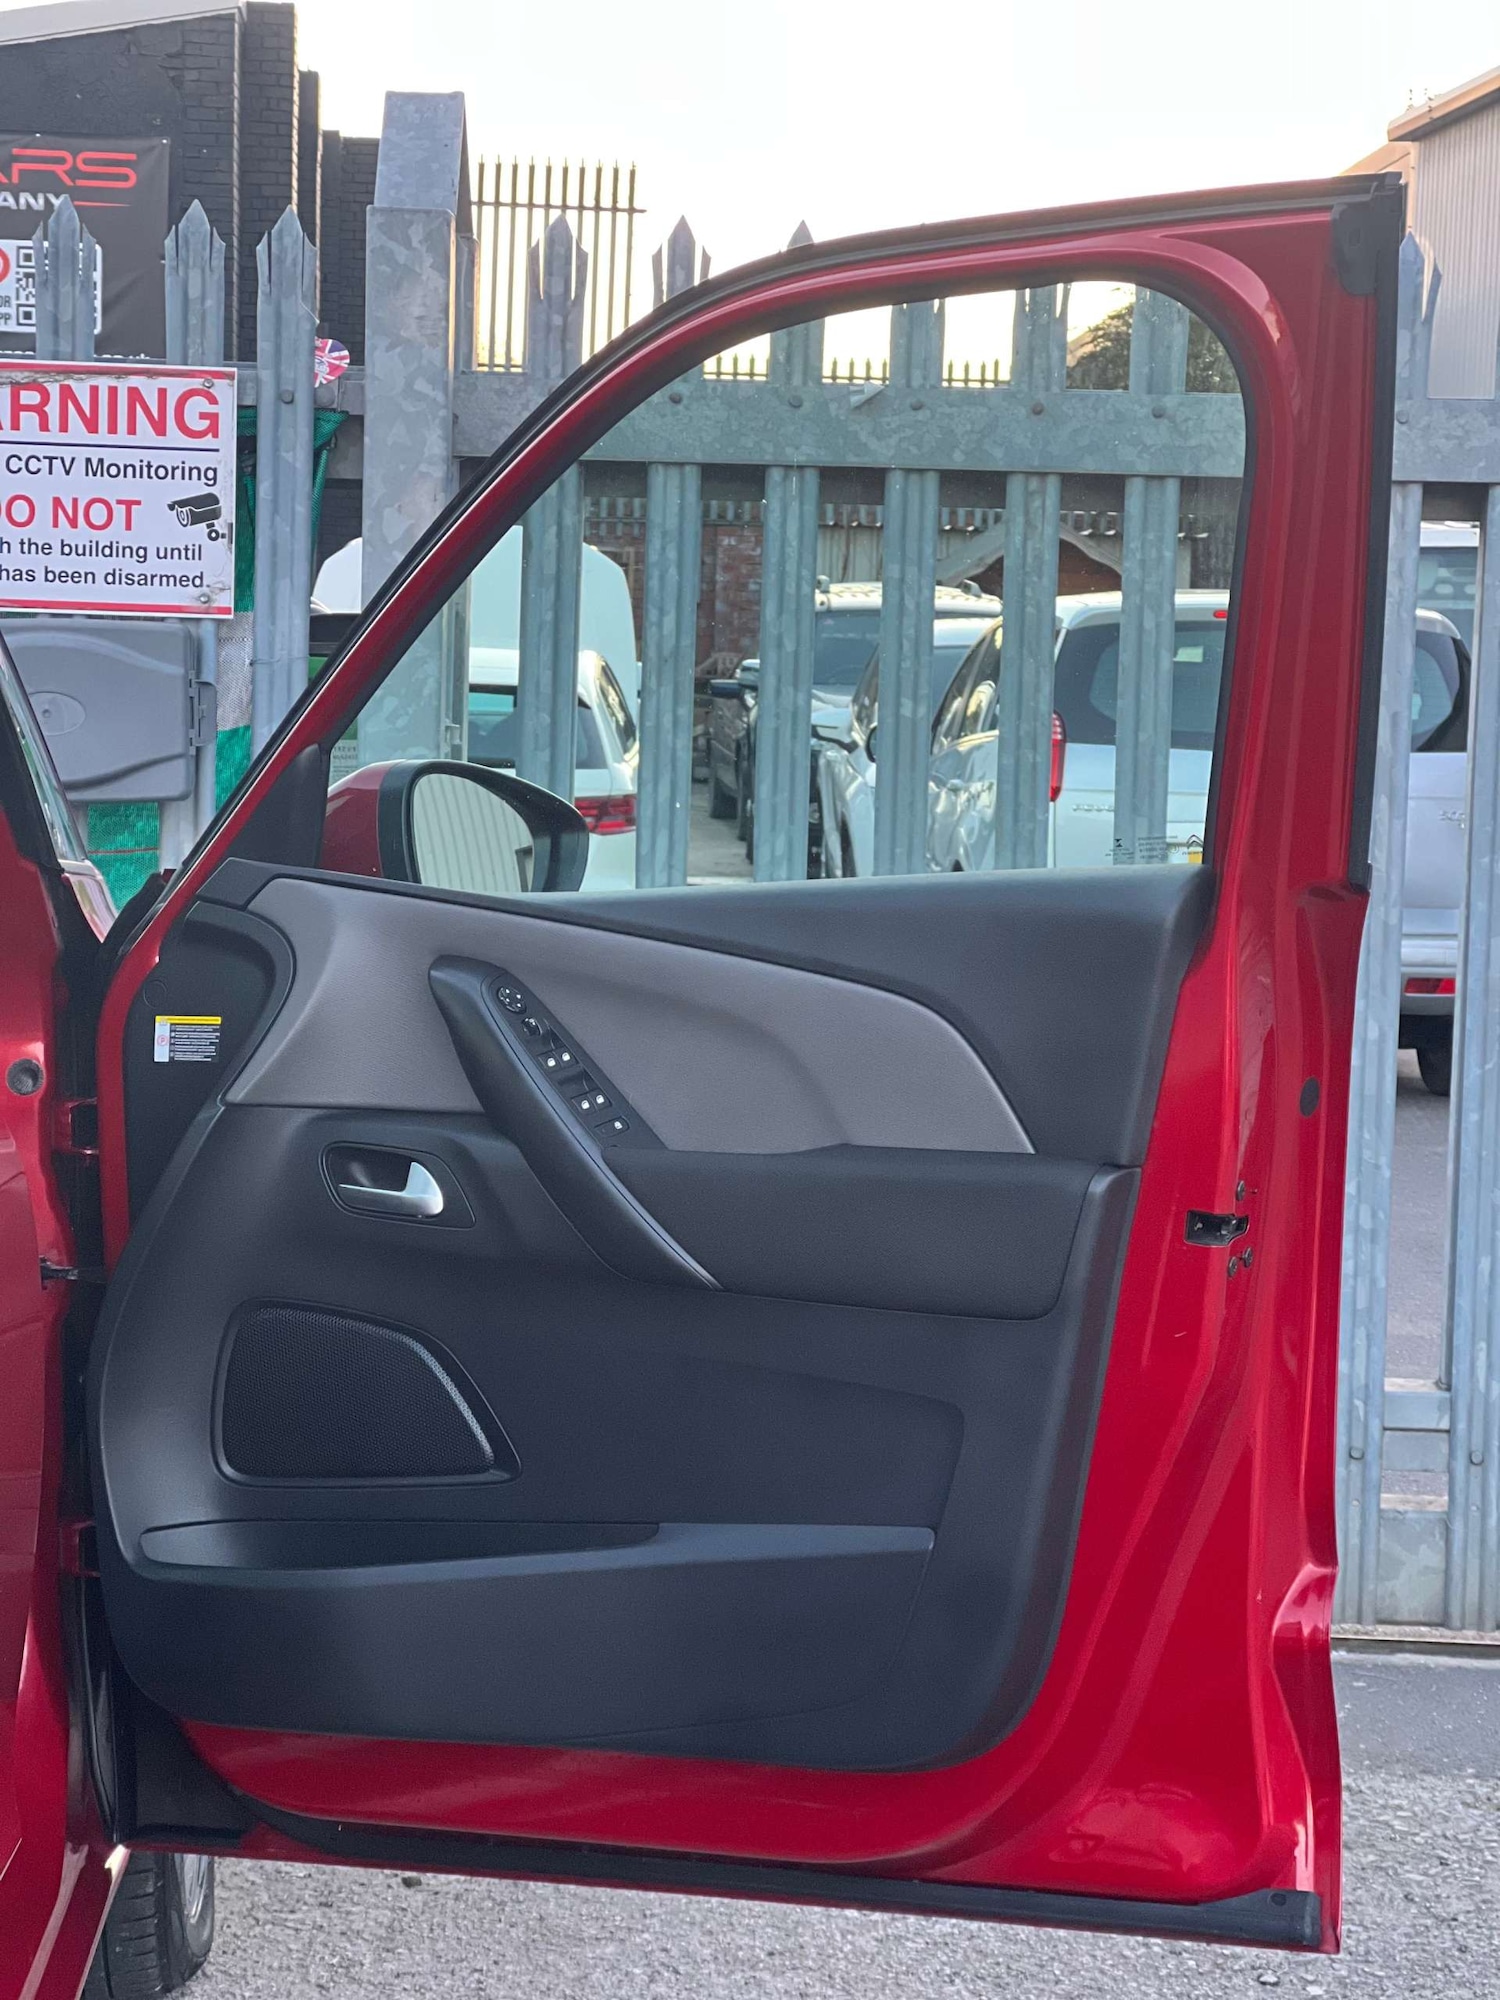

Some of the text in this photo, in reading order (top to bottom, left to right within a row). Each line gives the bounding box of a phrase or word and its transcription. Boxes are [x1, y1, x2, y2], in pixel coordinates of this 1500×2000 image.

[0, 148, 137, 189] RS
[0, 383, 219, 439] RNING
[5, 454, 218, 487] CCTV Monitoring
[0, 494, 142, 531] O NOT
[19, 537, 53, 556] the
[60, 539, 148, 563] building
[156, 544, 202, 561] until
[44, 565, 96, 584] been
[104, 568, 211, 588] disarmed.
